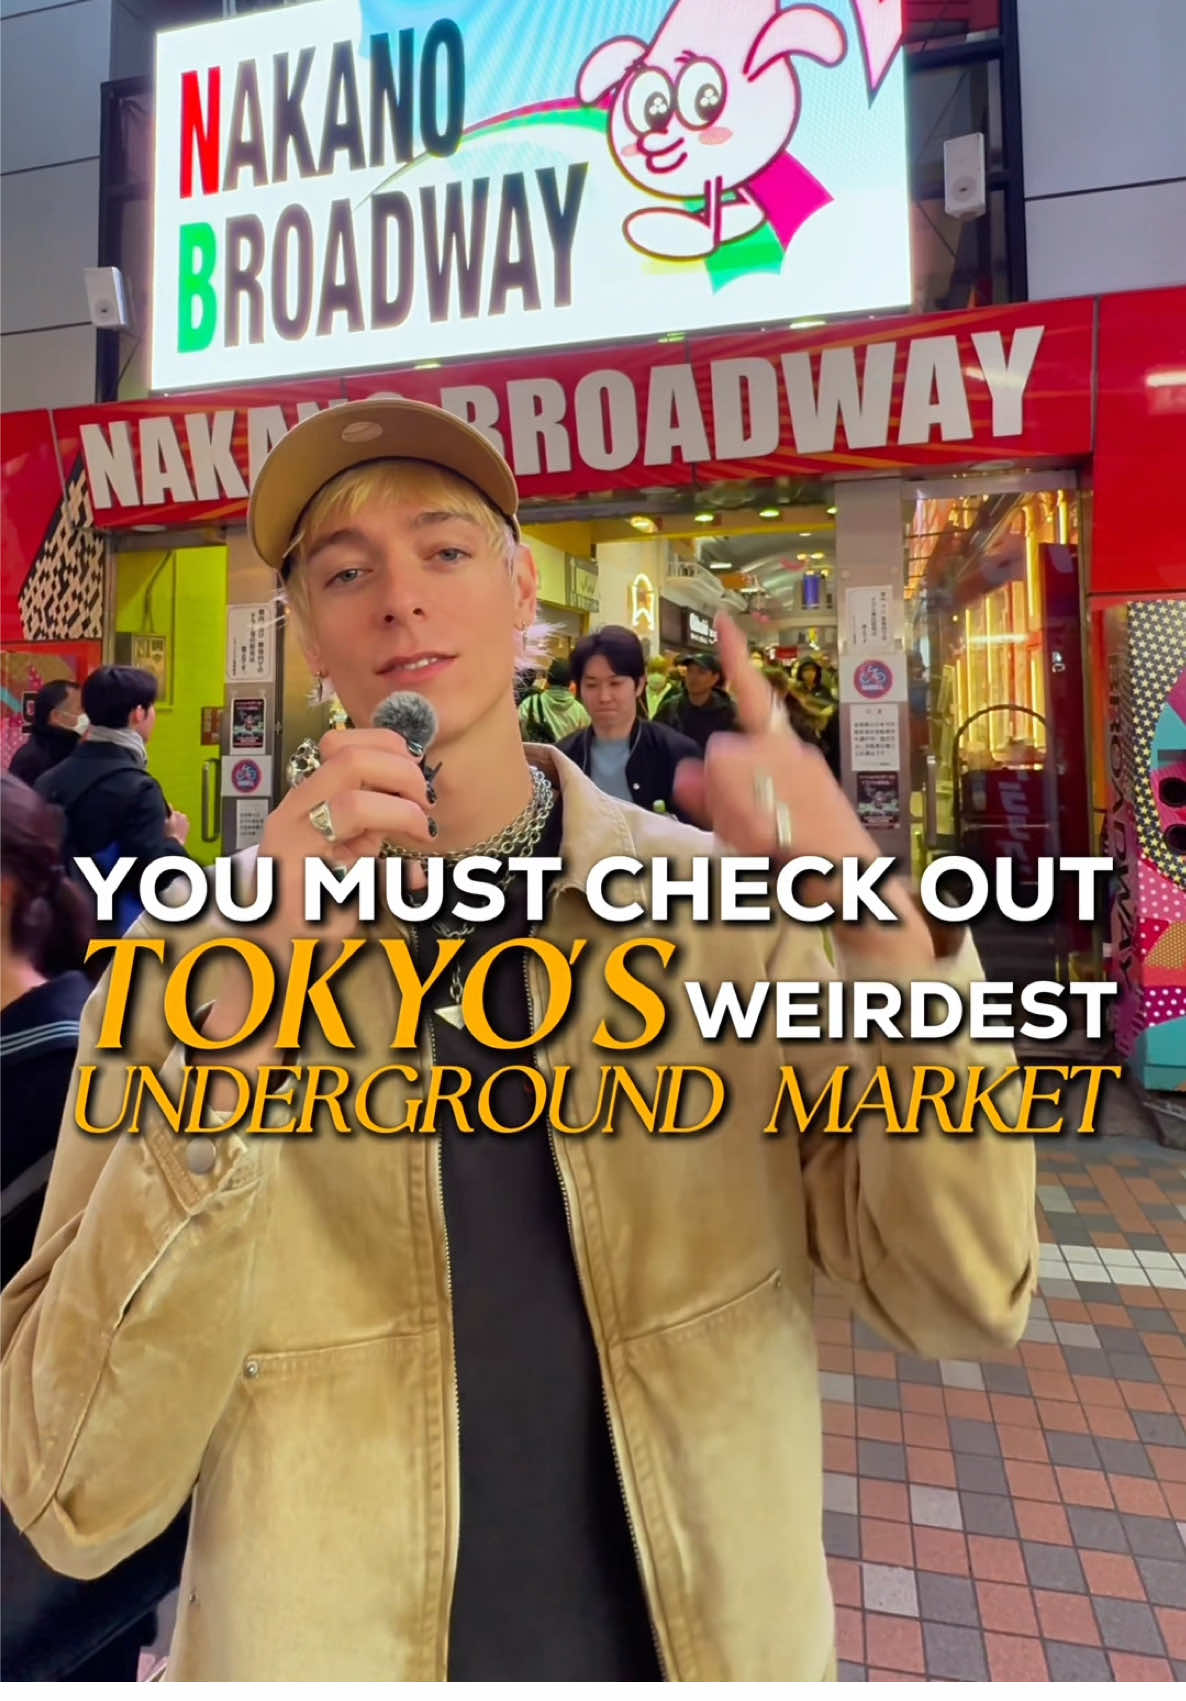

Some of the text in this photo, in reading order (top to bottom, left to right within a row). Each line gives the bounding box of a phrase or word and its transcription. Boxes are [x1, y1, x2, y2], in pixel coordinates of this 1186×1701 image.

[179, 18, 466, 199] NAKANO
[177, 161, 590, 354] BROADWAY
[80, 325, 1045, 509] NAKA BROADWAY
